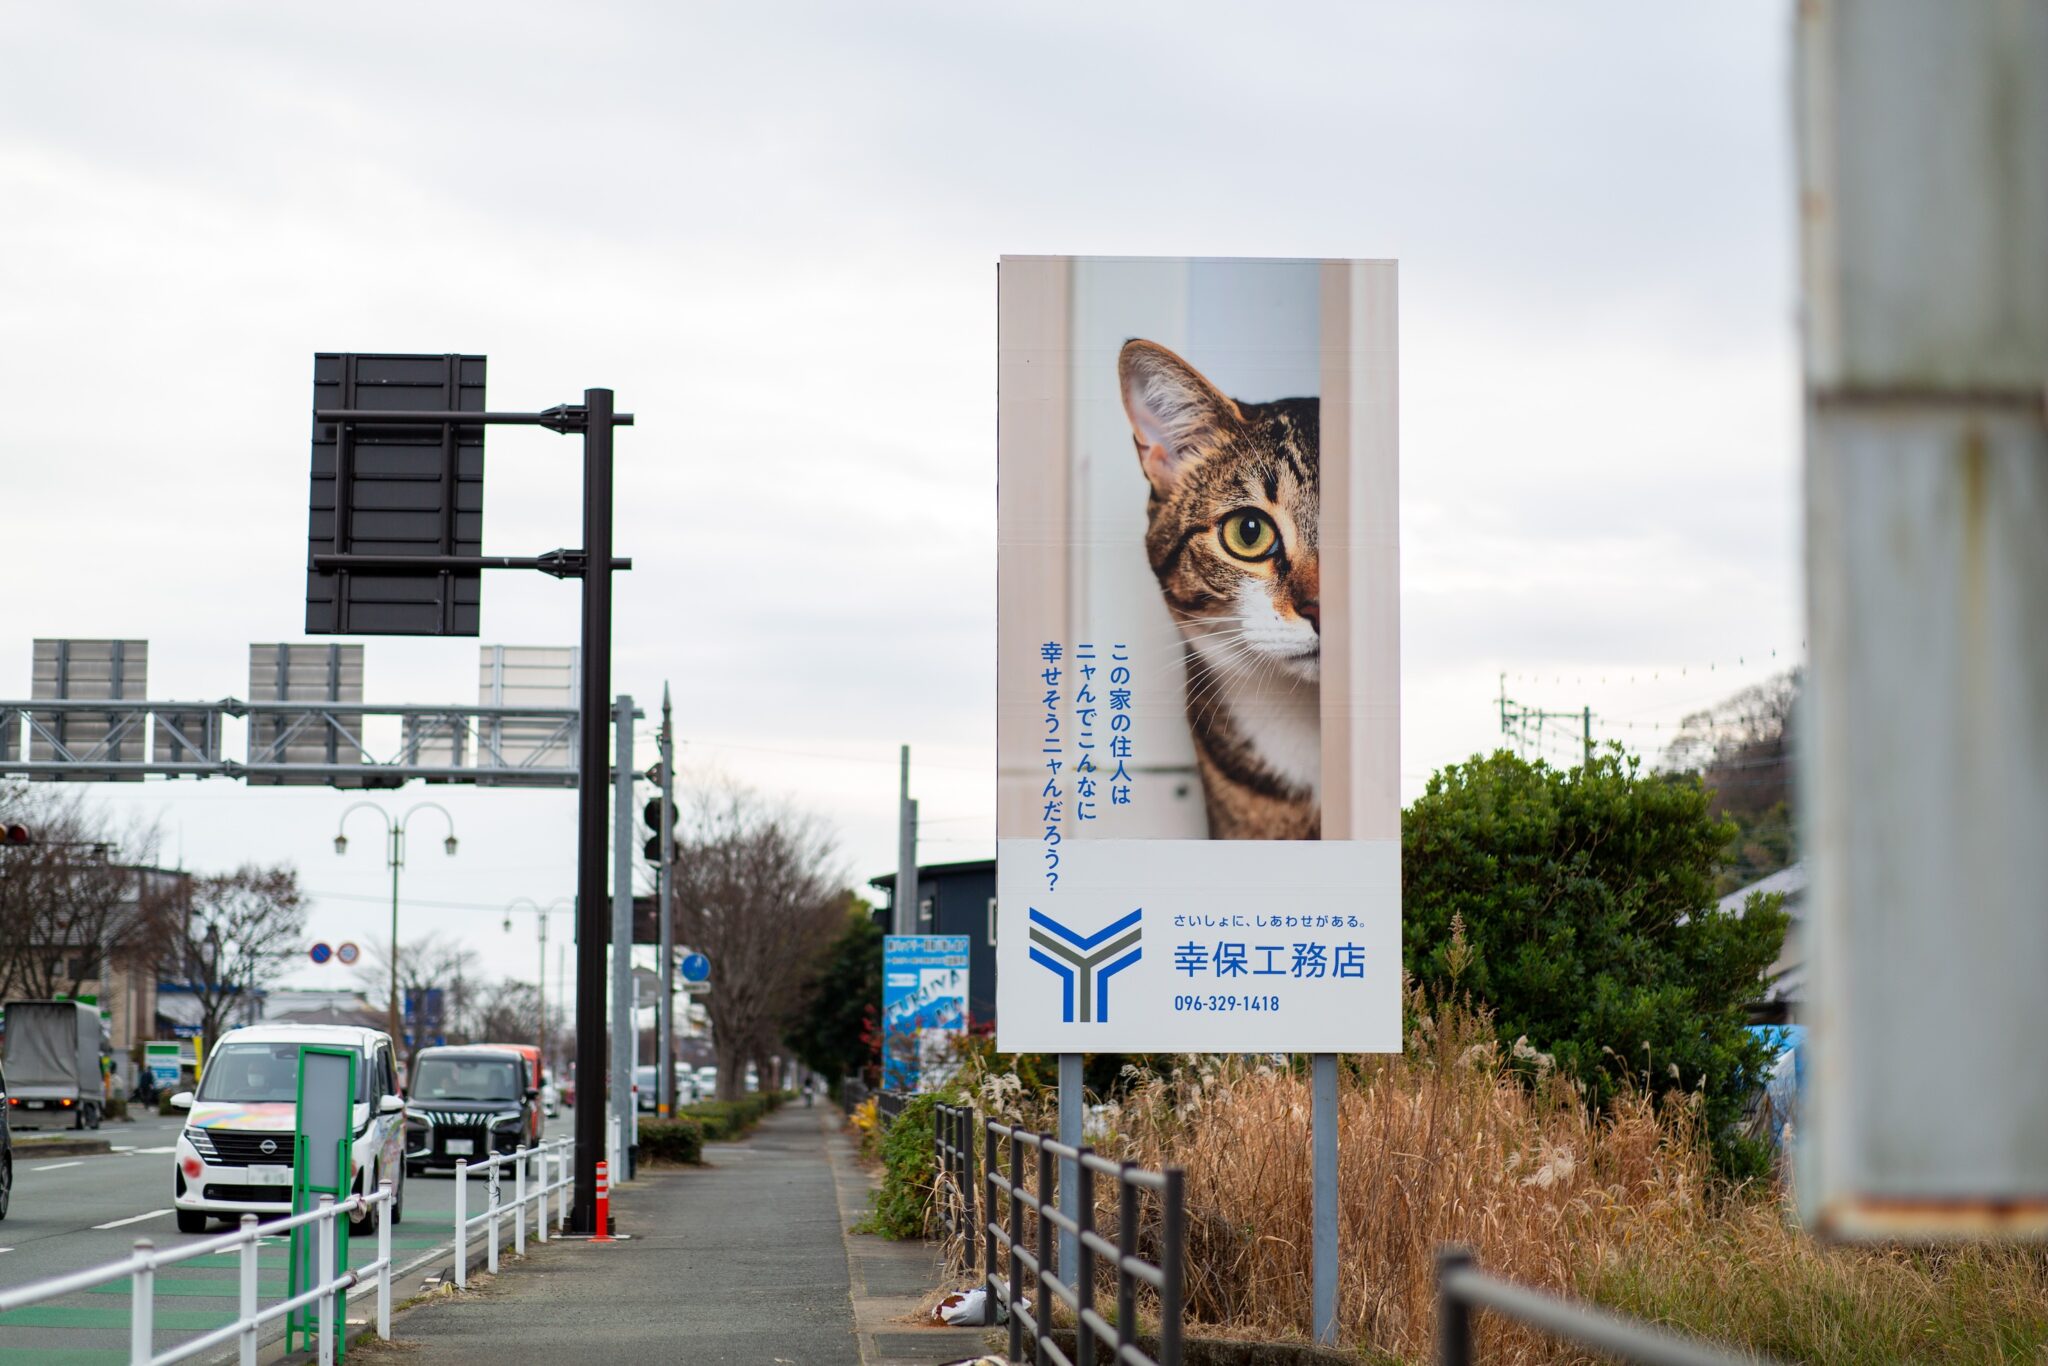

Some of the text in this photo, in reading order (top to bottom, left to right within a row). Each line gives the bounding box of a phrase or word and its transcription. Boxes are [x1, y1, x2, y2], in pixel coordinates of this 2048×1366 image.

[1041, 641, 1063, 892] 幸せそうニャんだろう？
[1075, 643, 1097, 821] ニャんでこんなに
[1109, 643, 1133, 805] この家の住人は
[1174, 914, 1365, 928] さいしょに、しあわせがある。
[1174, 940, 1366, 979] 幸保工務店
[1174, 995, 1280, 1012] 096-329-1418
